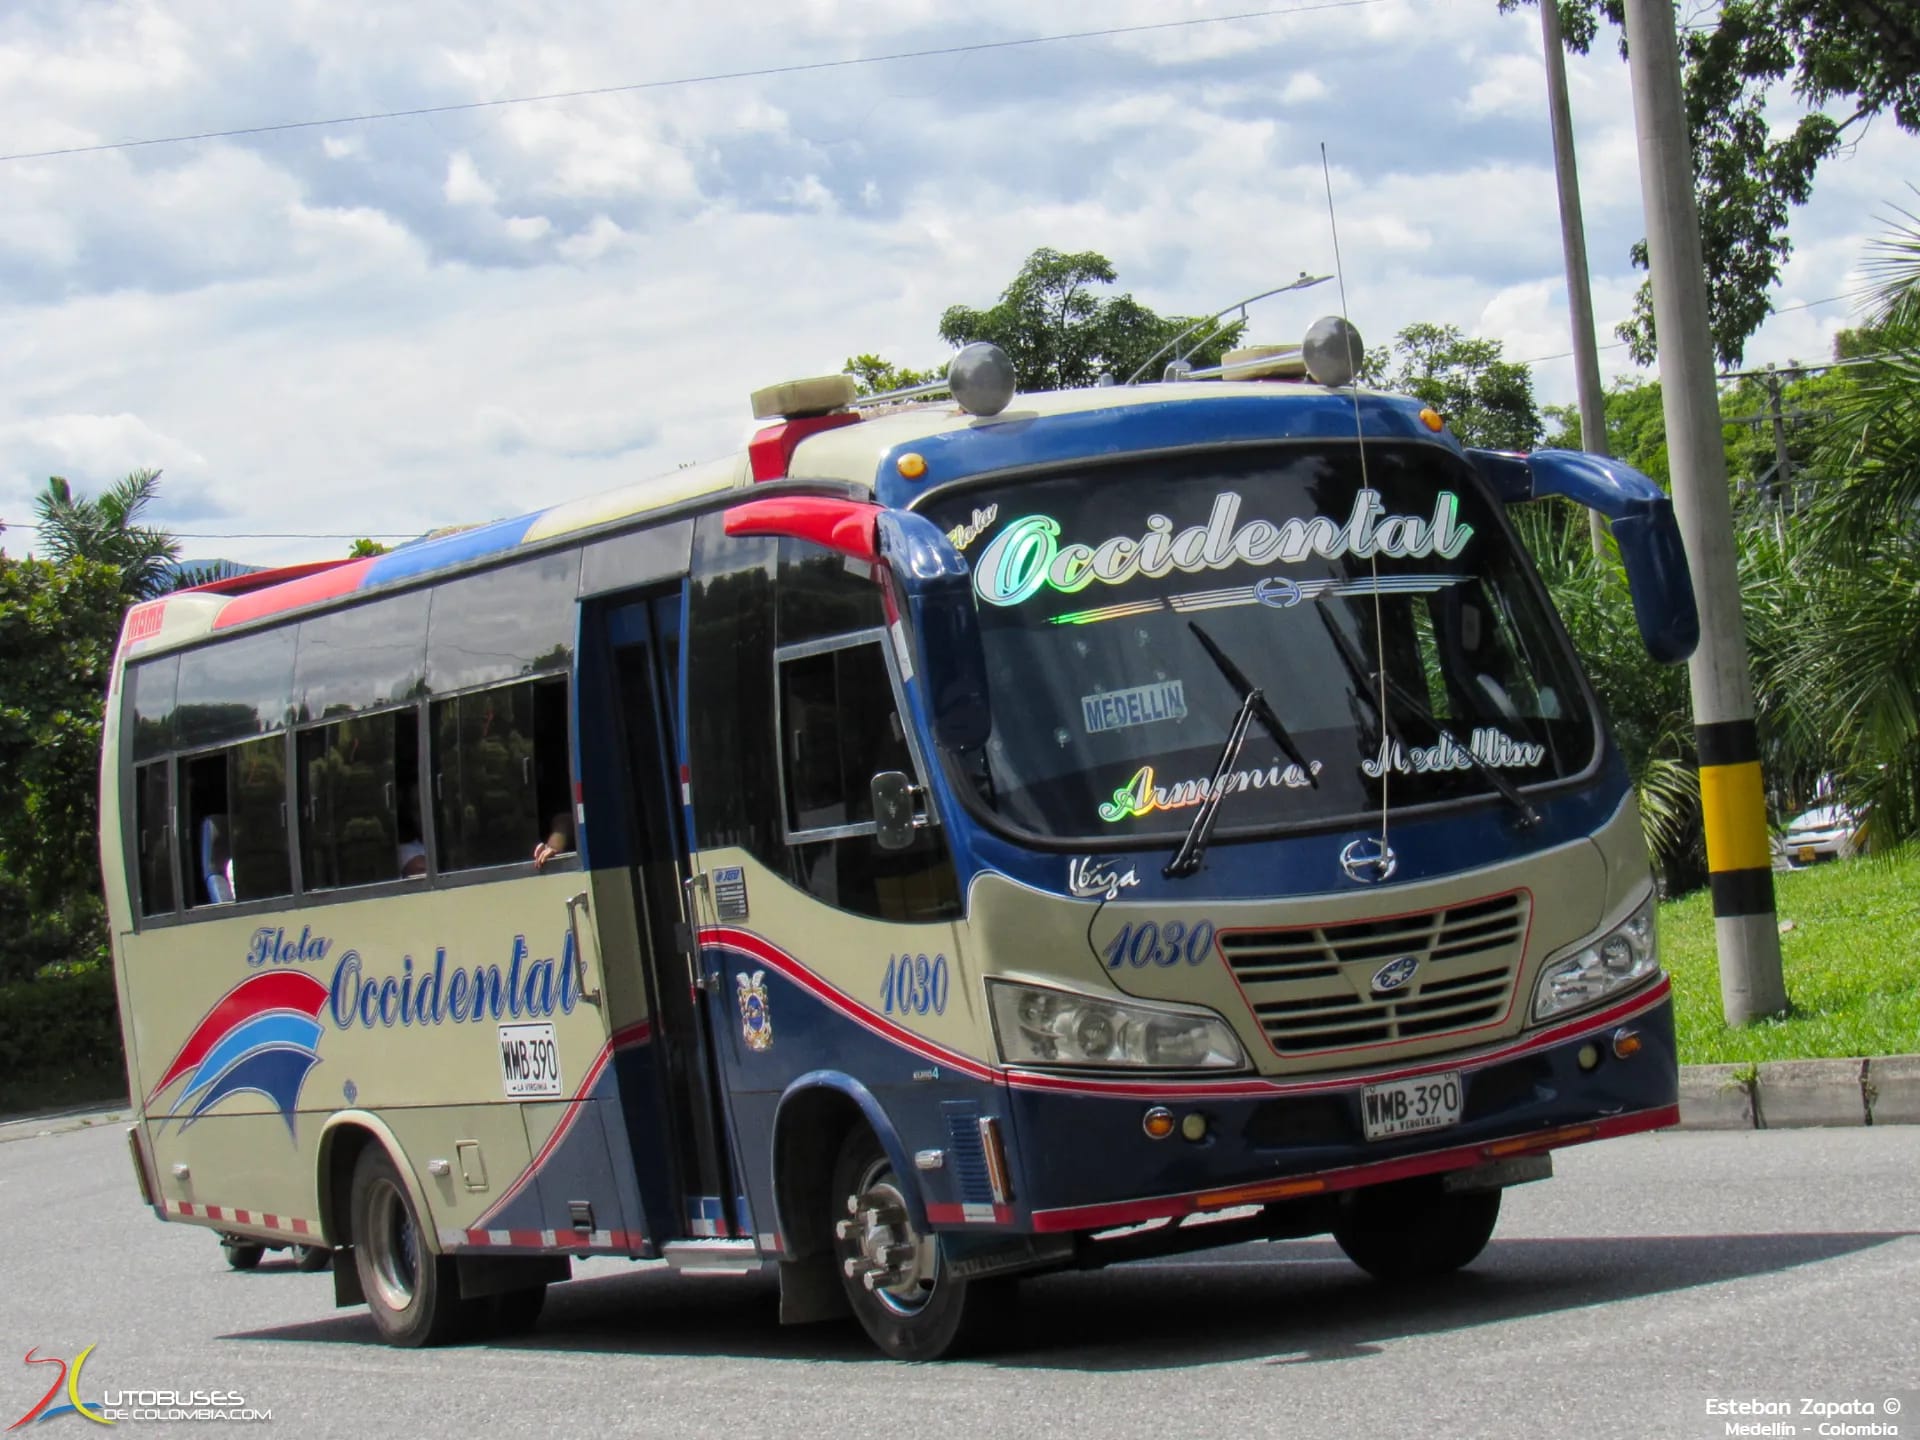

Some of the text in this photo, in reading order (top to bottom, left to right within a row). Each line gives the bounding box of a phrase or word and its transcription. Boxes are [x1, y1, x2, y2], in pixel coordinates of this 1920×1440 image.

[974, 490, 1475, 607] Occidental
[1085, 685, 1186, 732] MEDELLIN
[1361, 727, 1546, 778] Medellin
[1068, 857, 1141, 900] Ibiza
[1103, 919, 1215, 970] 1030
[247, 924, 587, 1030] Flota Occidental
[880, 953, 949, 1016] 1030
